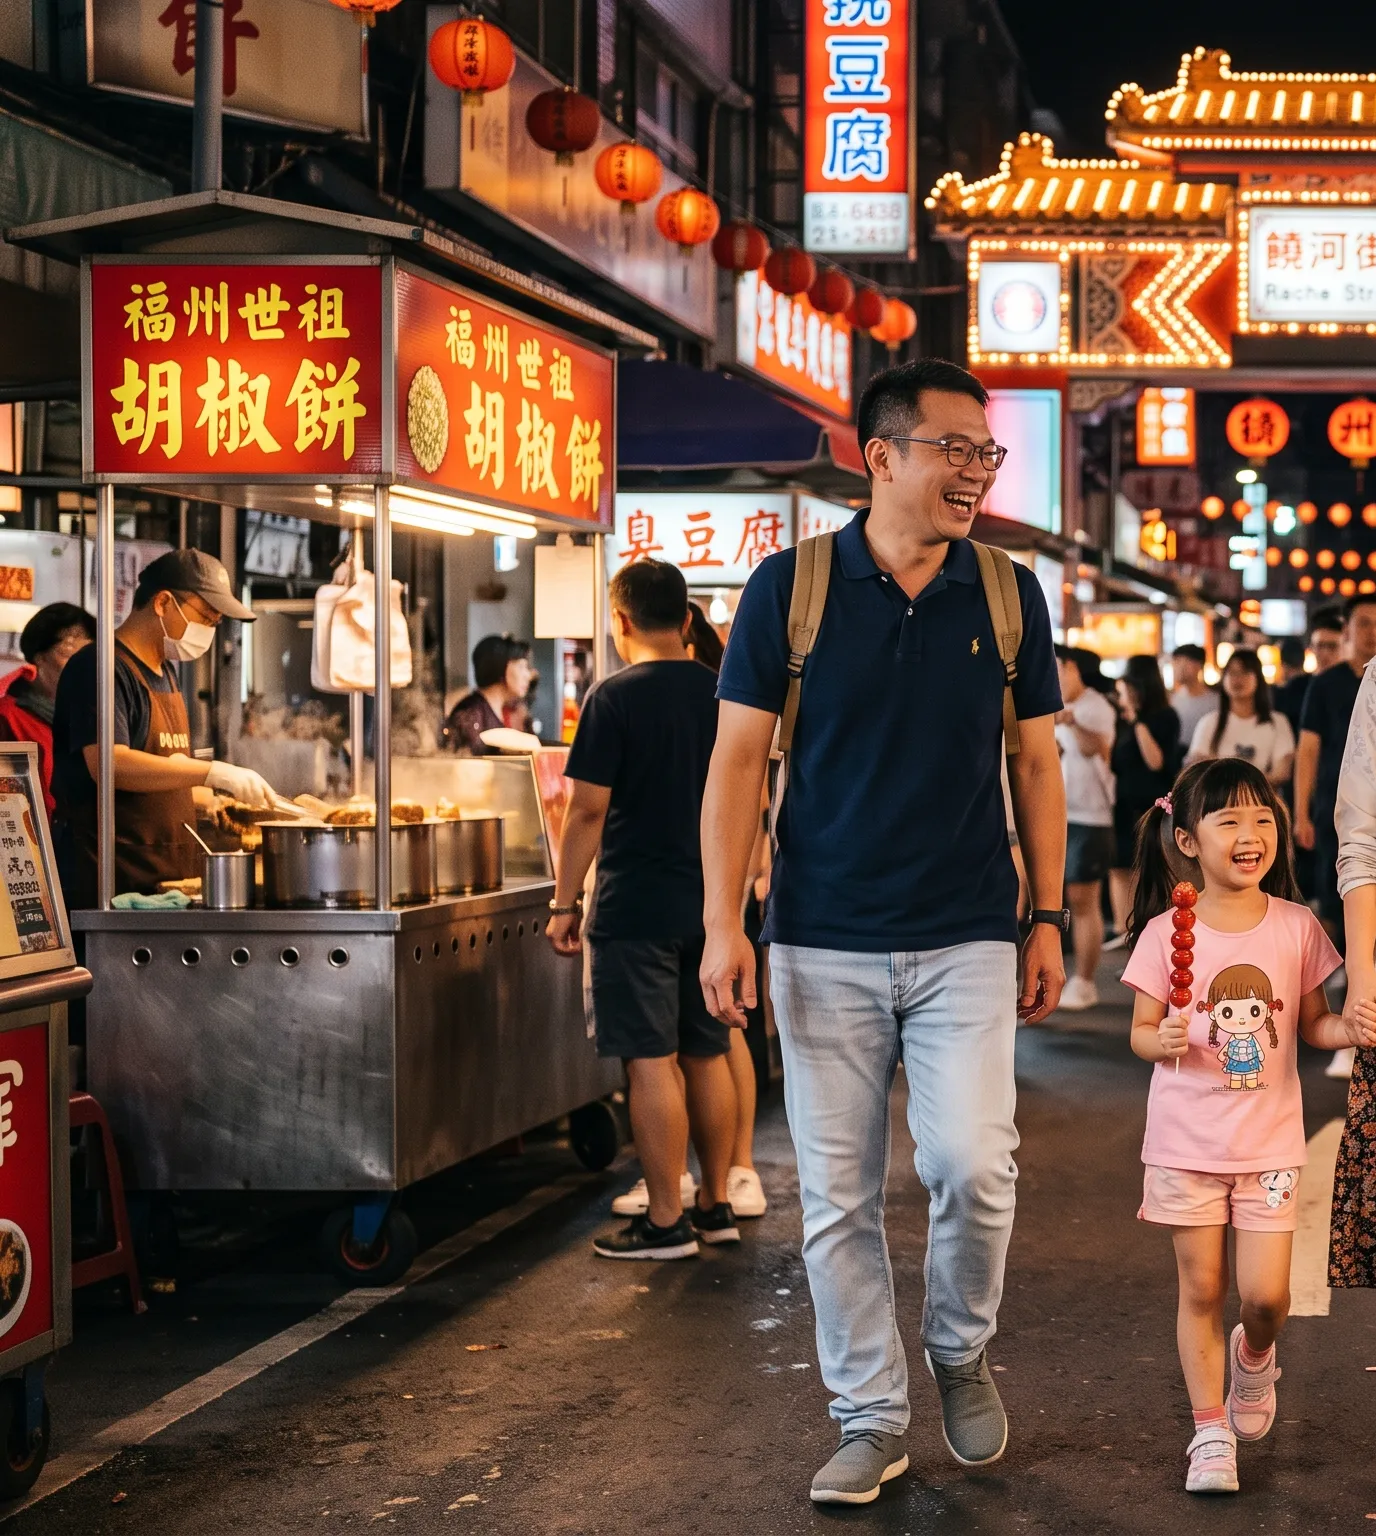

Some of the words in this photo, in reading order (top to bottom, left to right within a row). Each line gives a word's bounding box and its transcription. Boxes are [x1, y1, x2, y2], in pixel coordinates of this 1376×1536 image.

[124, 281, 350, 344] 福州世祖
[444, 305, 575, 402] 福州世祖
[110, 356, 367, 460] 胡椒餅
[463, 382, 604, 513] 胡椒餅
[619, 509, 784, 568] 臭豆腐
